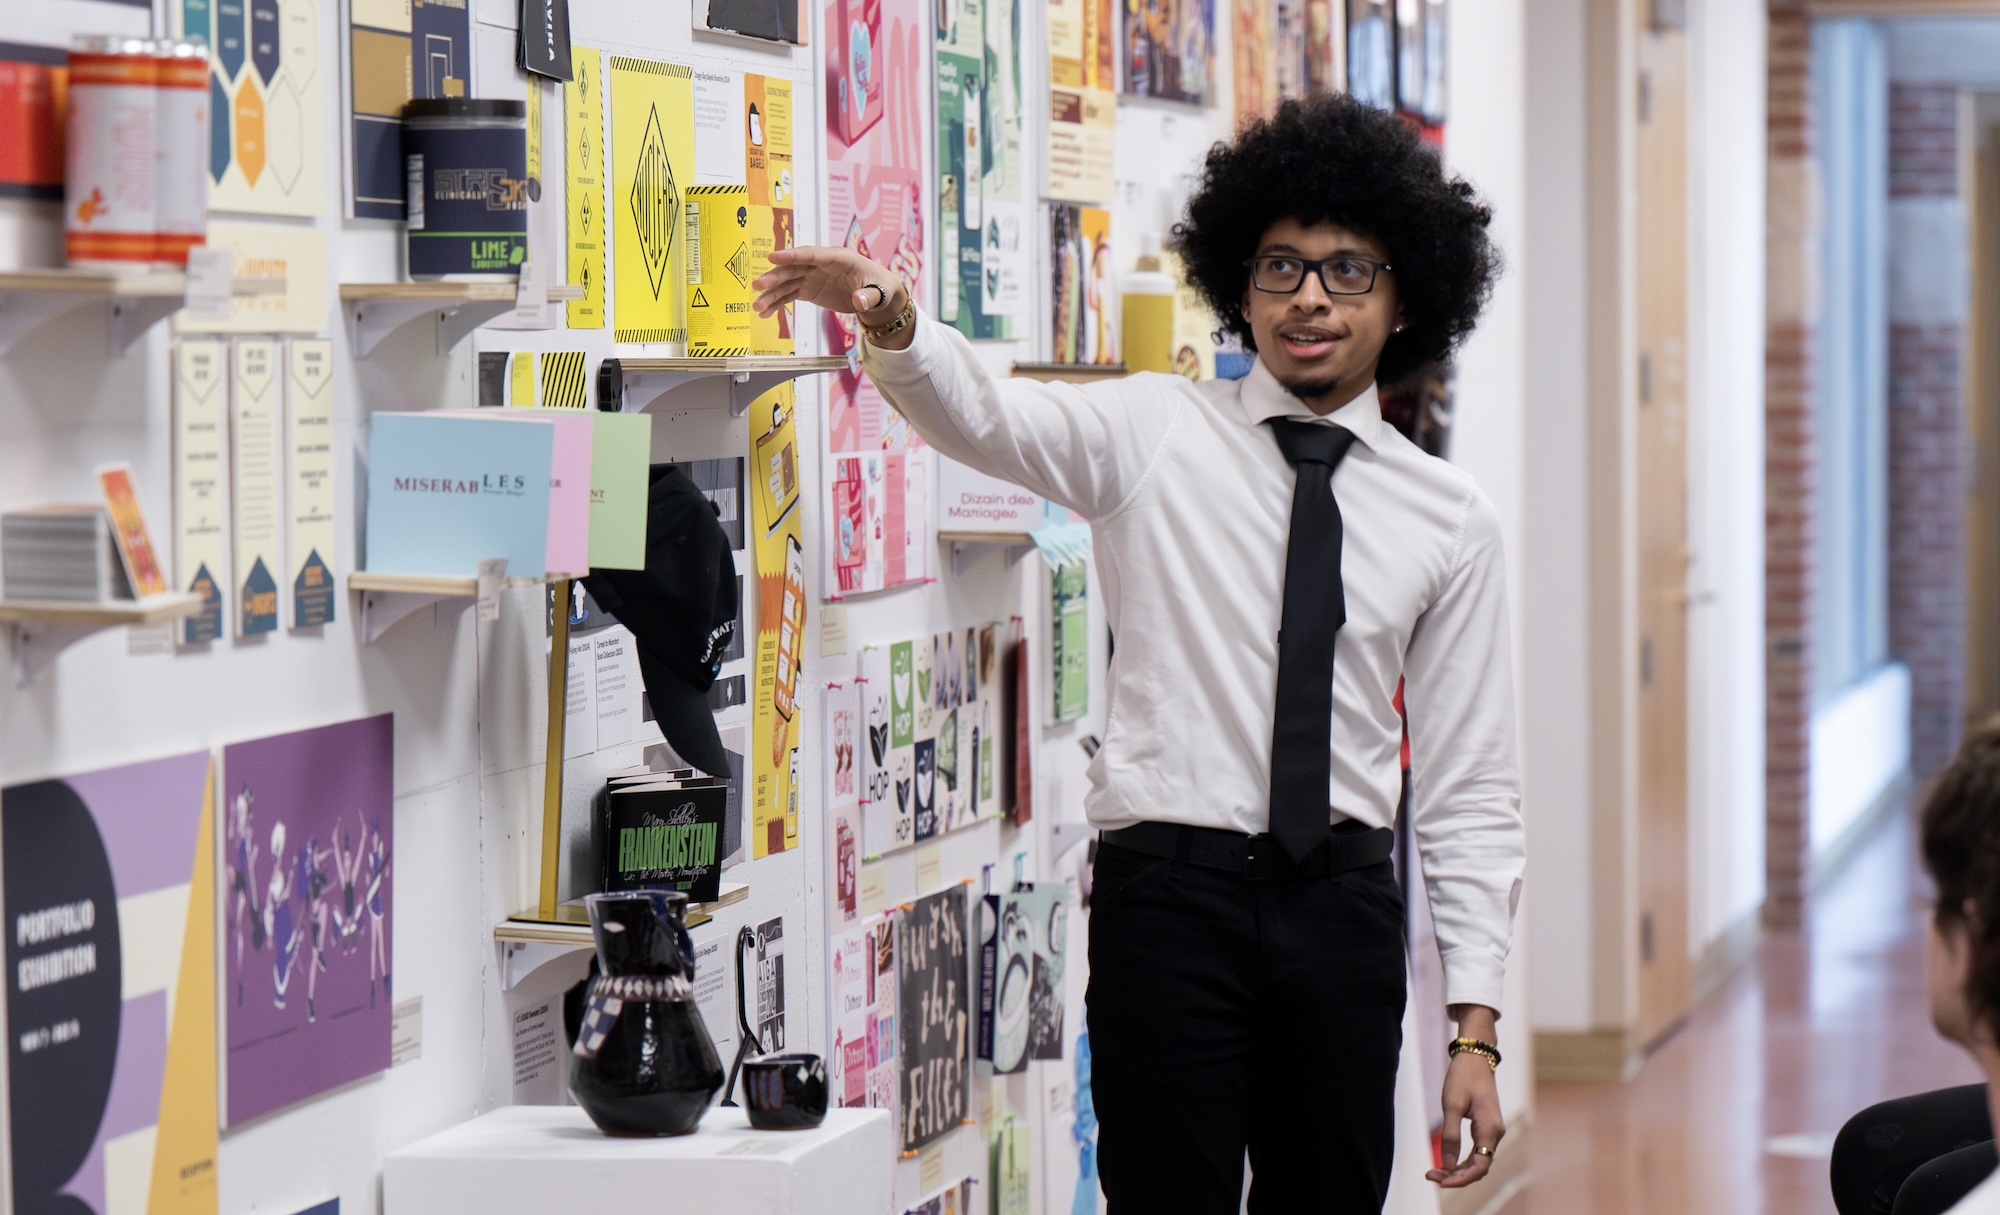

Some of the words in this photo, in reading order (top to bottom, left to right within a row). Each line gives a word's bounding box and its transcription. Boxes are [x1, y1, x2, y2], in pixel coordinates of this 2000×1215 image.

[471, 241, 509, 260] LIME
[725, 302, 746, 314] ENERGY
[960, 492, 1005, 506] Dizain
[1007, 493, 1036, 506] des
[895, 712, 912, 738] HOP
[919, 707, 932, 731] HOP
[869, 771, 890, 805] HOP
[896, 818, 912, 843] HOP
[917, 809, 933, 836] HOP
[618, 822, 718, 873] FRANKENSTEIN
[16, 900, 95, 948] PORTFOLIO
[18, 942, 97, 992] EXHIBITION
[758, 959, 776, 983] AIGA
